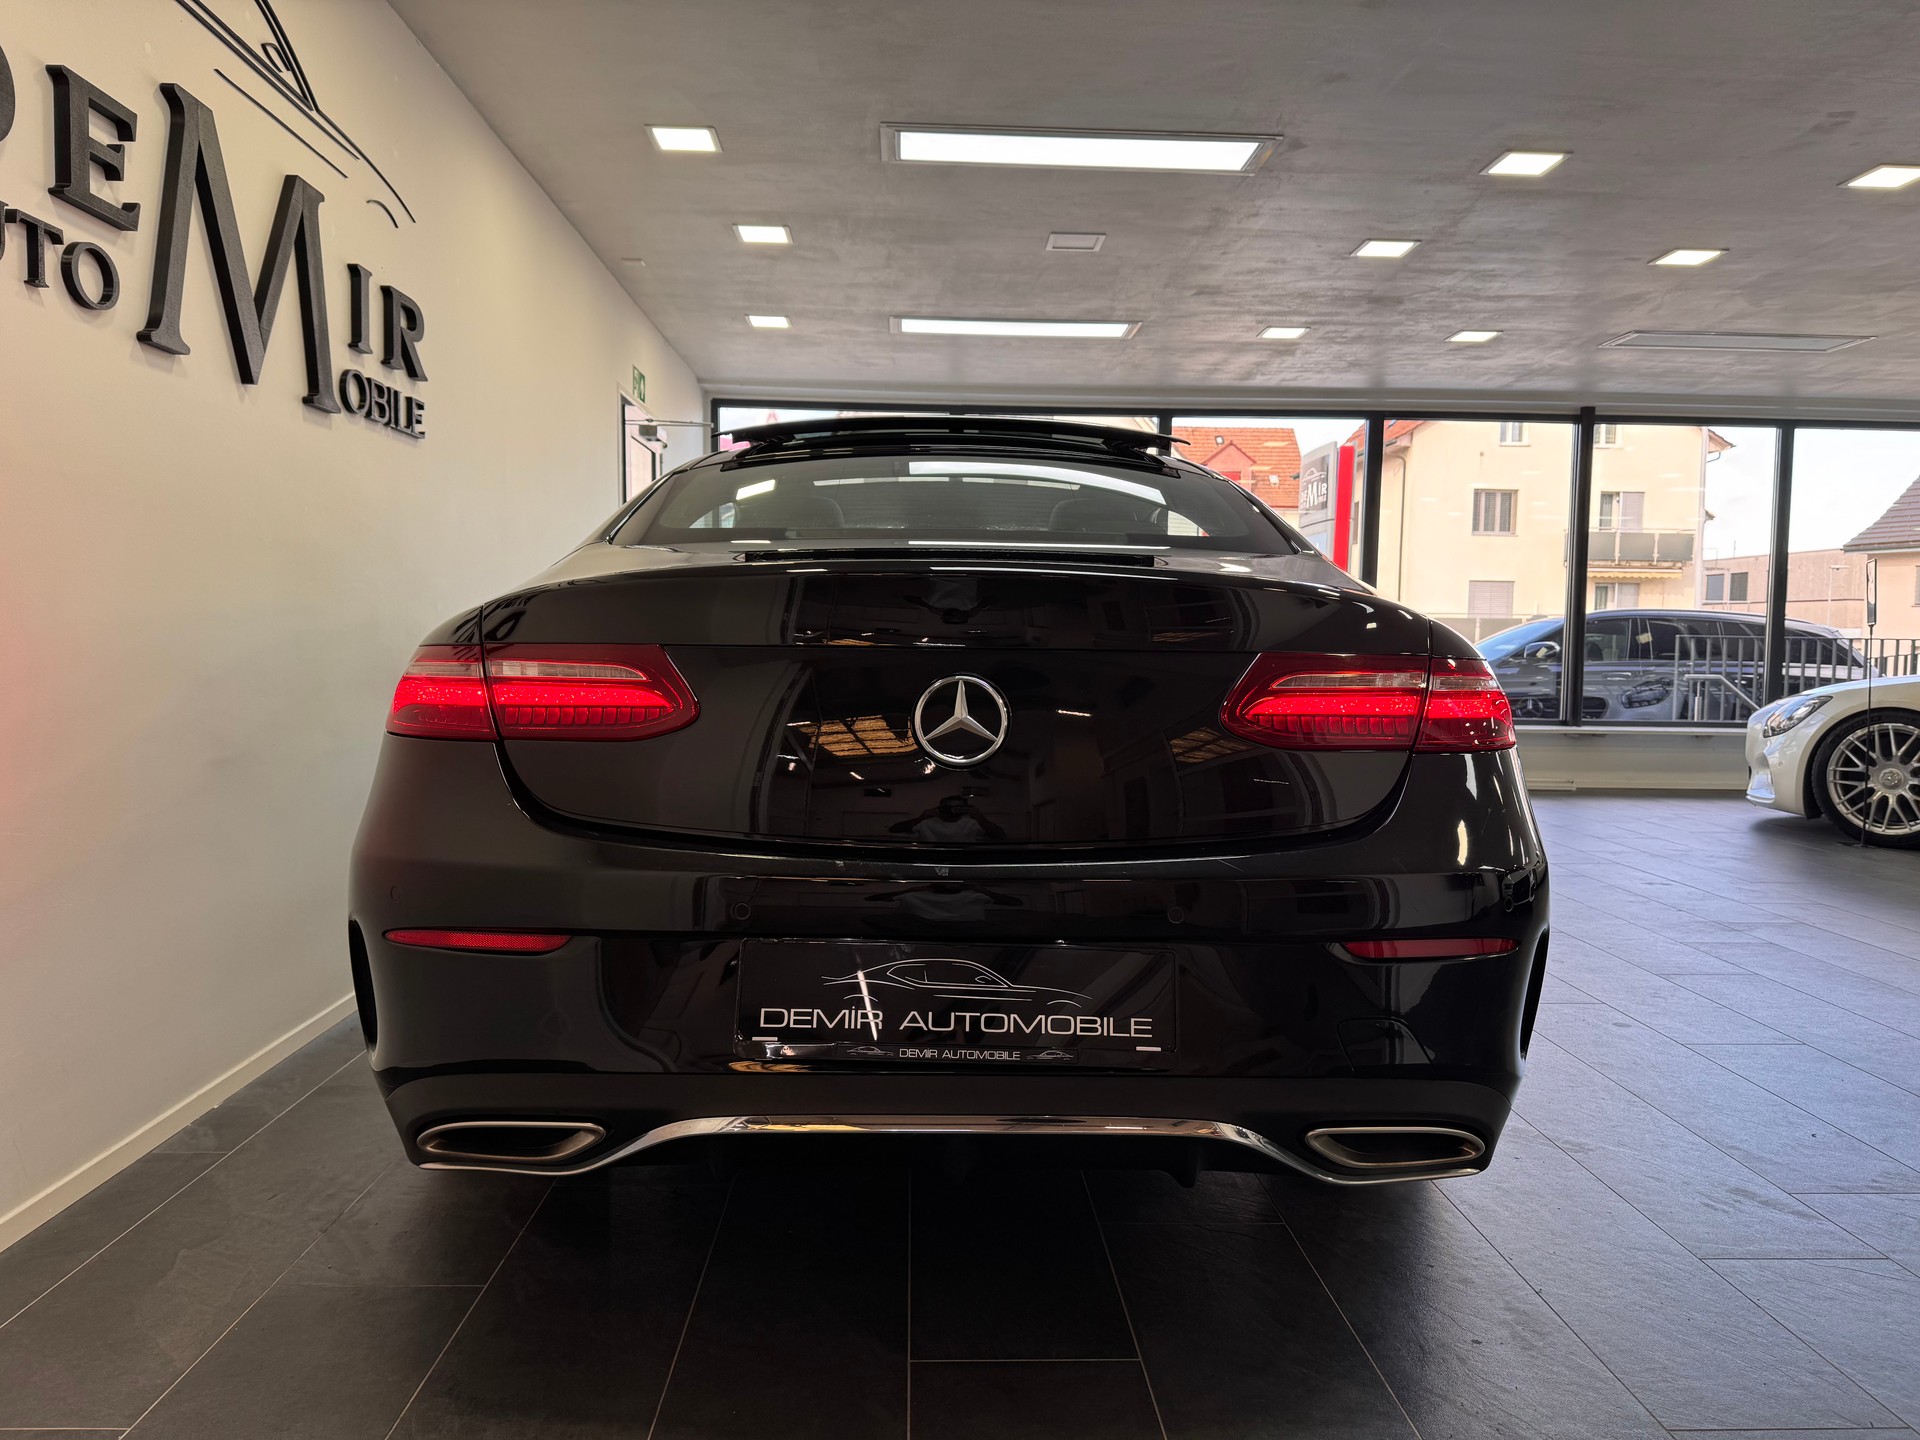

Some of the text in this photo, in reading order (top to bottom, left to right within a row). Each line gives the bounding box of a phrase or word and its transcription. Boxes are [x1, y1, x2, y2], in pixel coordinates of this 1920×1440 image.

[0, 46, 428, 414] EMIR
[0, 200, 120, 311] TO
[899, 1010, 1153, 1038] AUTOMOBILE
[942, 1049, 1021, 1061] AUTOMOBILE
